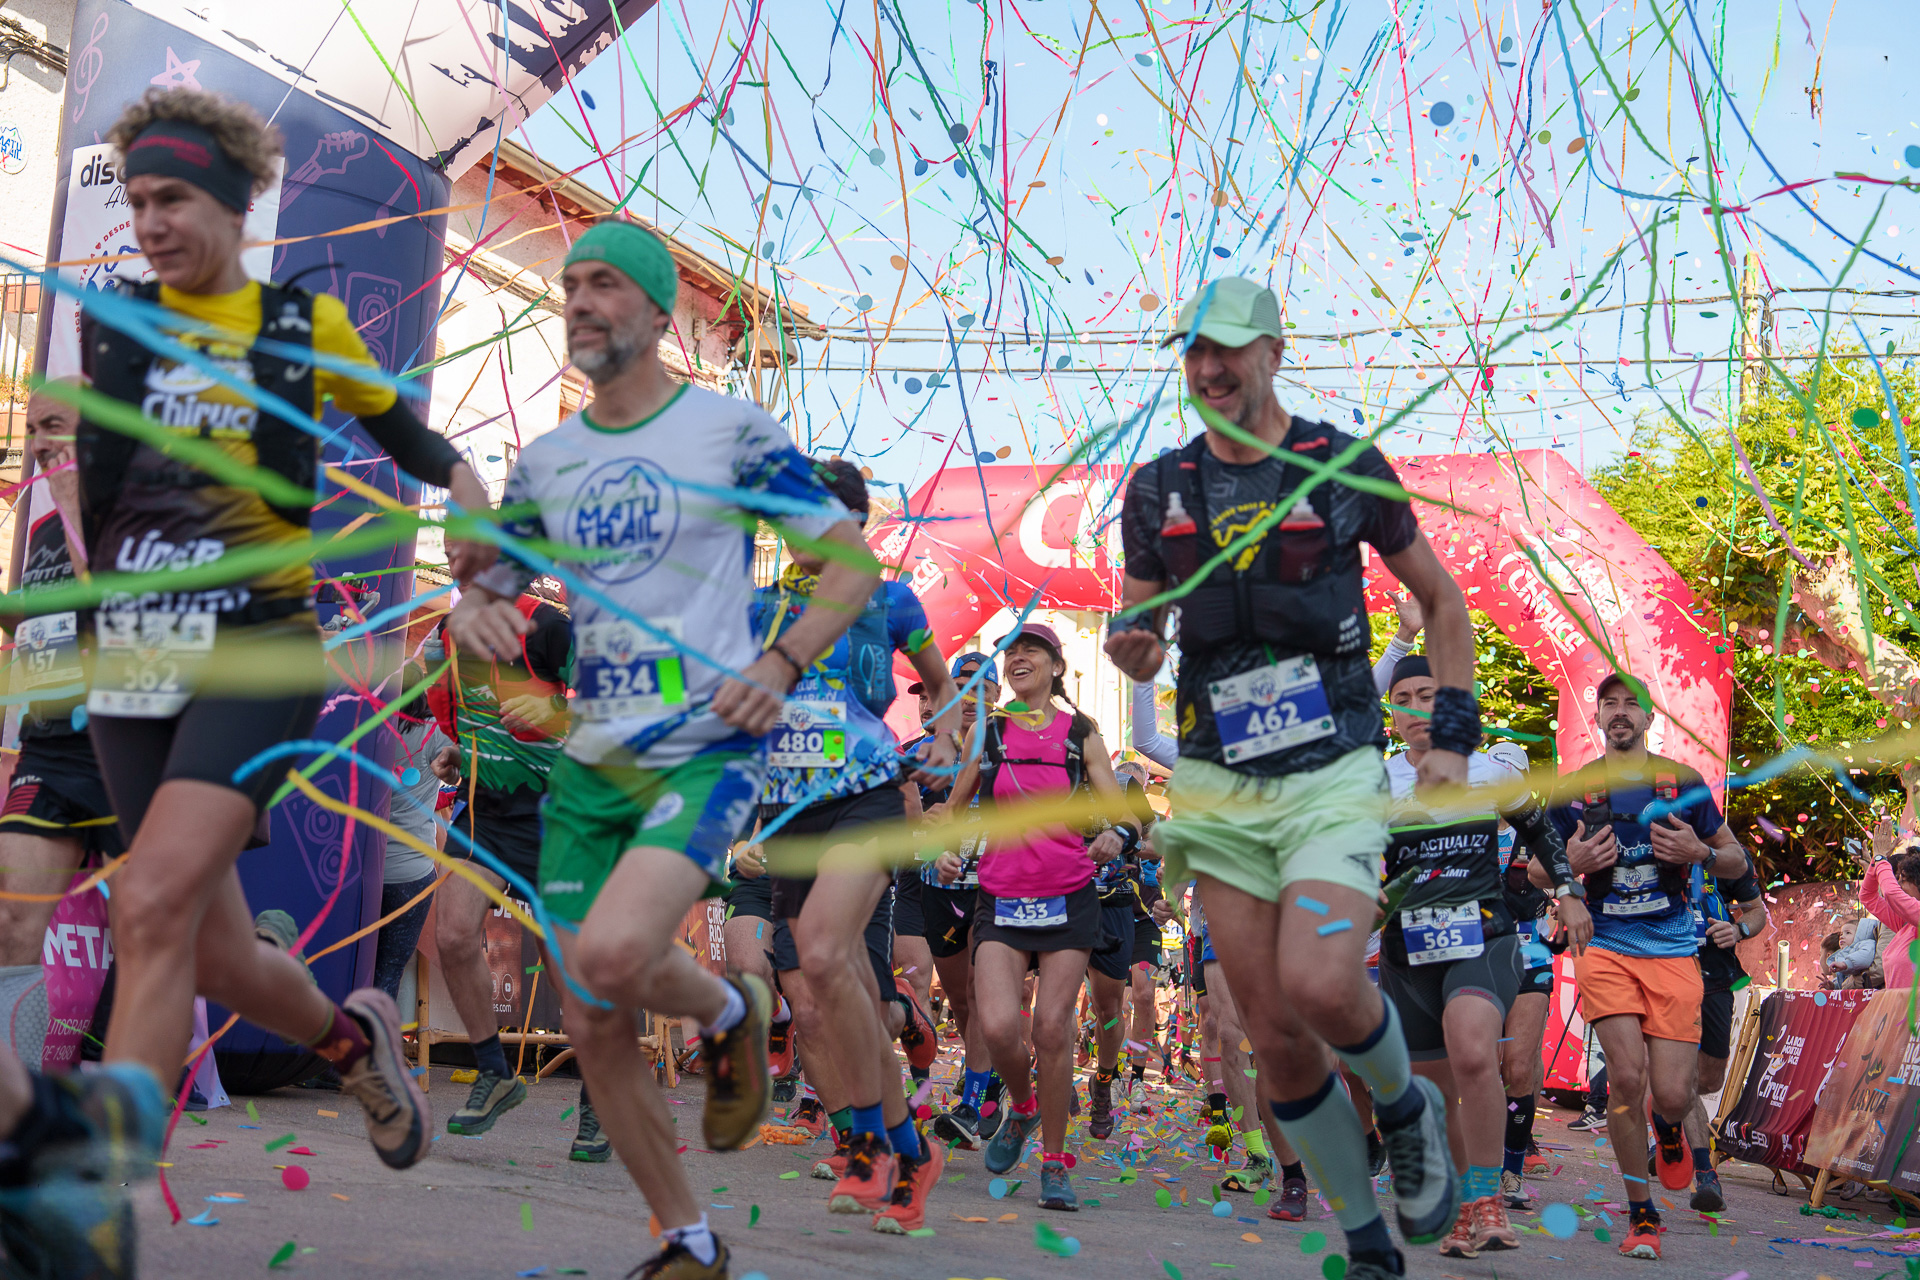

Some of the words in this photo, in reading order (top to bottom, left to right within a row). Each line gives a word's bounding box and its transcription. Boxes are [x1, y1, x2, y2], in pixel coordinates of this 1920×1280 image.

[103, 220, 131, 242] DESDE
[597, 665, 655, 697] 524
[1246, 701, 1302, 736] 462
[778, 732, 823, 753] 480
[707, 905, 726, 926] CIRC
[1013, 902, 1048, 920] 453
[43, 923, 115, 969] META
[1423, 928, 1464, 950] 565
[711, 942, 722, 961] DE
